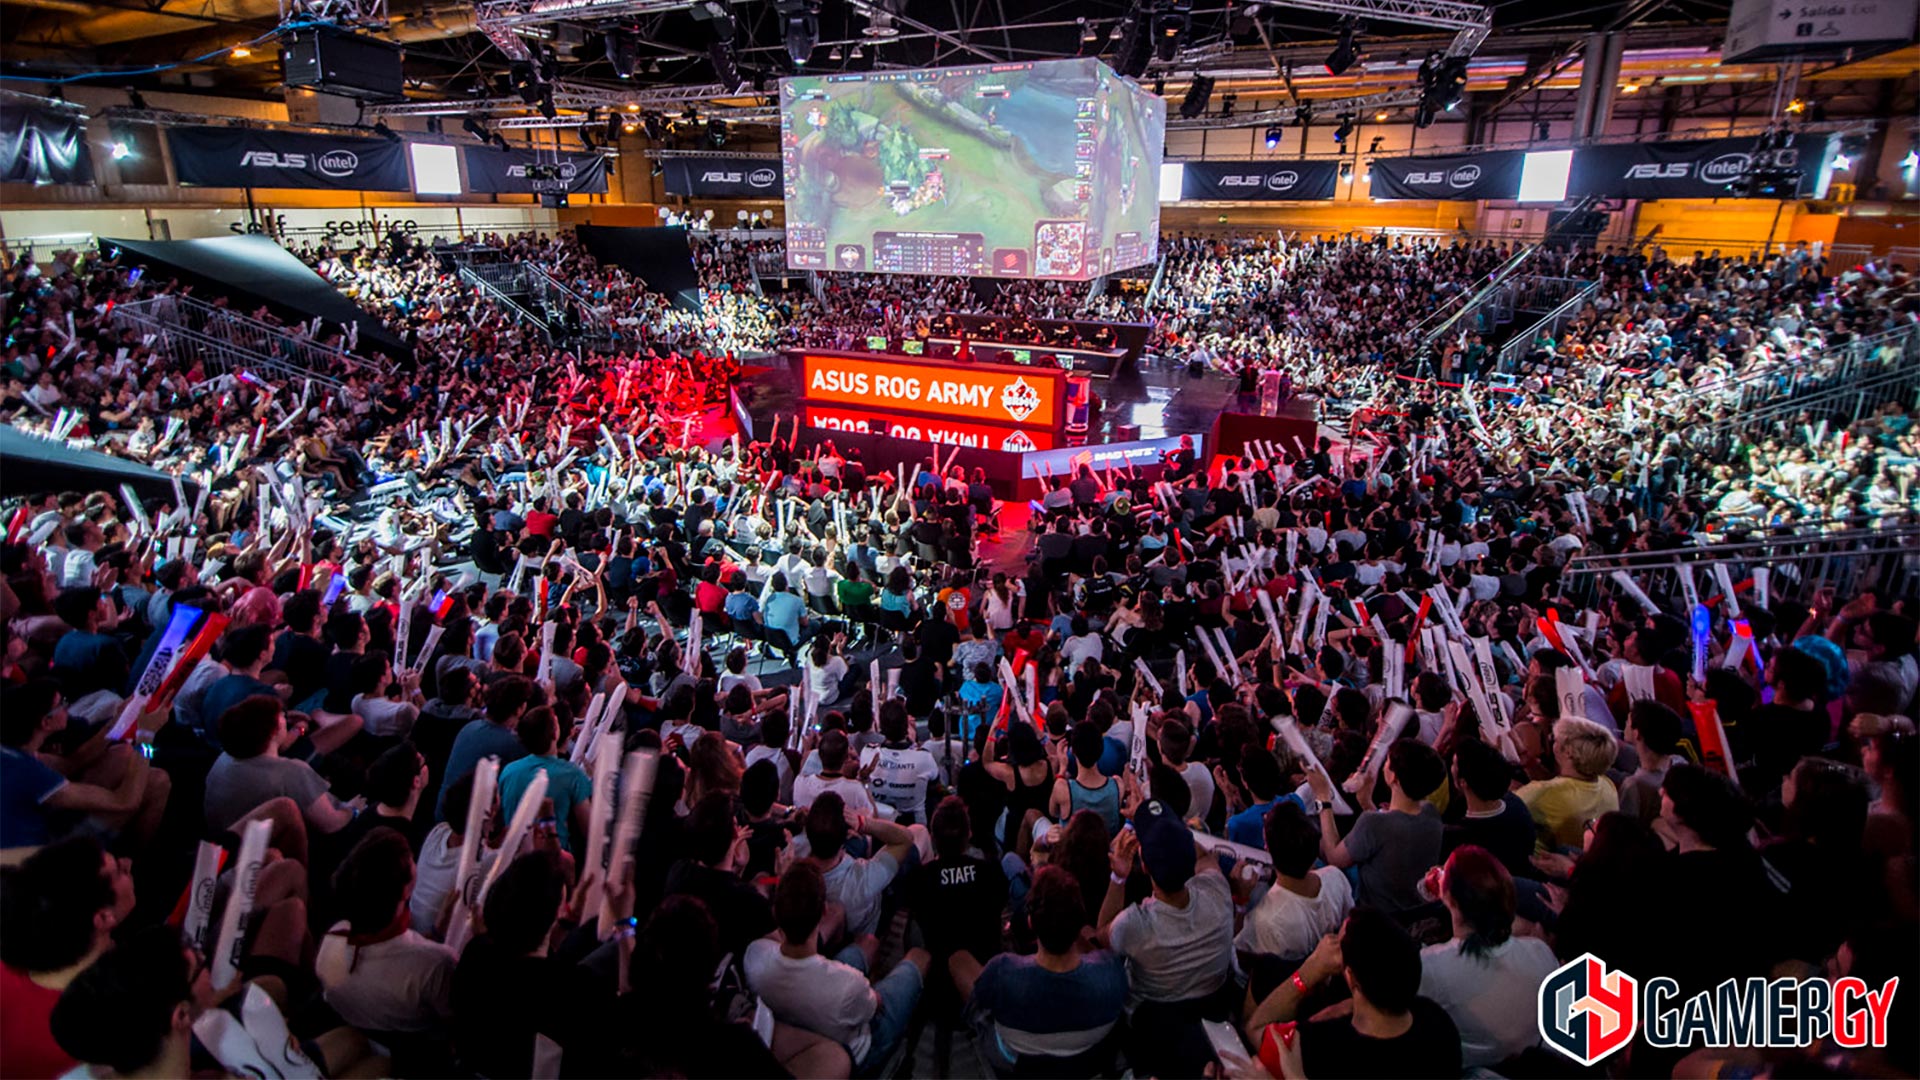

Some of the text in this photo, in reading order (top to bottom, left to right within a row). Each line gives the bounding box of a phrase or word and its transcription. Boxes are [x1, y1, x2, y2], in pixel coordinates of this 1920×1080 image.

[1800, 5, 1877, 17] Salida Exit
[241, 150, 307, 169] ASUS
[701, 172, 743, 183] ASUS
[1402, 171, 1443, 184] ASUS
[1624, 162, 1692, 179] ASUS
[1218, 175, 1262, 186] ASUS
[326, 213, 418, 237] service
[811, 369, 994, 408] ASUS ROG ARMY
[940, 864, 976, 886] STAFF
